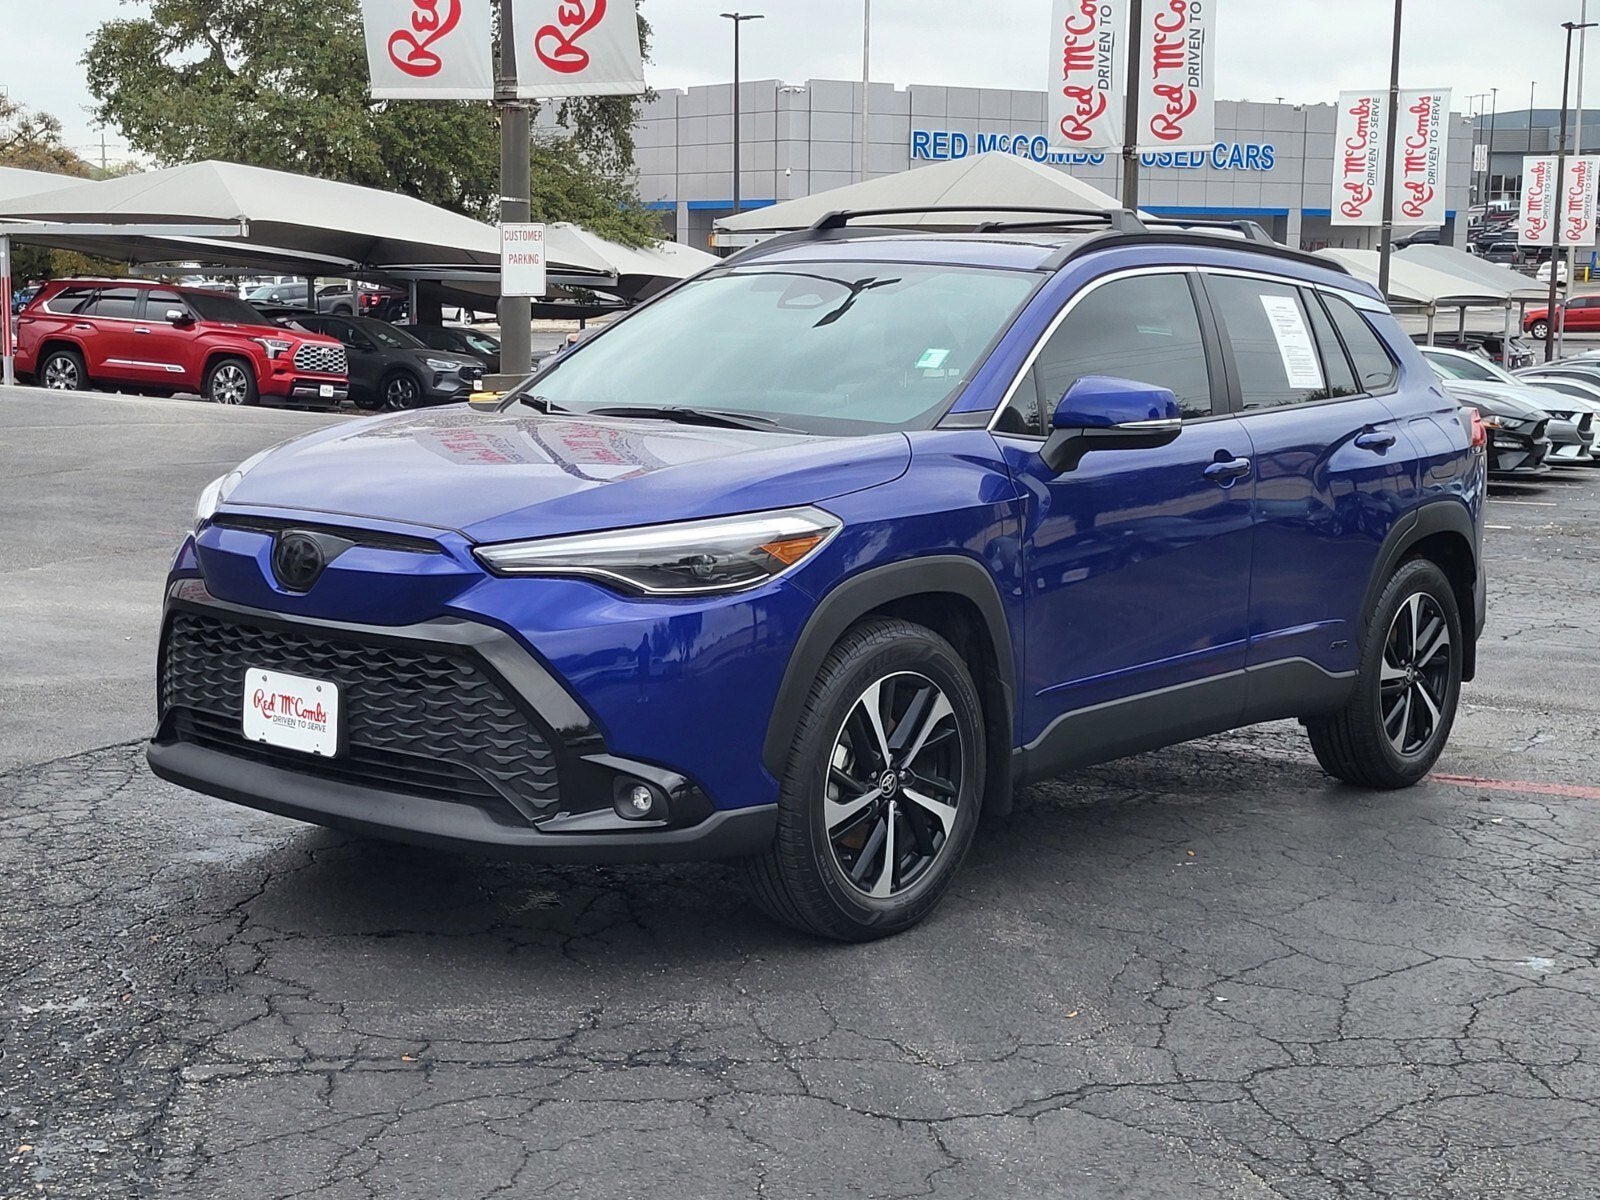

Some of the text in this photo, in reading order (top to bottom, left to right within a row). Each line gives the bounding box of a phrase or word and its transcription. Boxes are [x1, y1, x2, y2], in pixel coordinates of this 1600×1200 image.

[1098, 5, 1112, 90] DRIVEN TO
[1188, 2, 1202, 87] DRIVEN TO
[1061, 86, 1106, 141] Red
[1150, 83, 1197, 140] Red
[912, 131, 968, 159] RED
[1213, 143, 1275, 170] CARS
[1341, 98, 1372, 217] Red McCombs
[1367, 97, 1380, 185] DRIVEN TO SERVE
[1402, 96, 1434, 217] Red McCombs
[1428, 95, 1441, 185] DRIVEN TO SERVE
[1525, 161, 1547, 240] Red McCombs
[1544, 184, 1551, 192] TO
[1566, 161, 1588, 240] Red McCombs
[1583, 194, 1591, 219] DRIVEN
[1586, 183, 1592, 192] TO
[504, 230, 543, 241] CUSTOMER
[508, 253, 539, 264] PARKING
[253, 688, 326, 724] Red McCombs
[272, 715, 327, 733] DRIVEN TO SERVE
